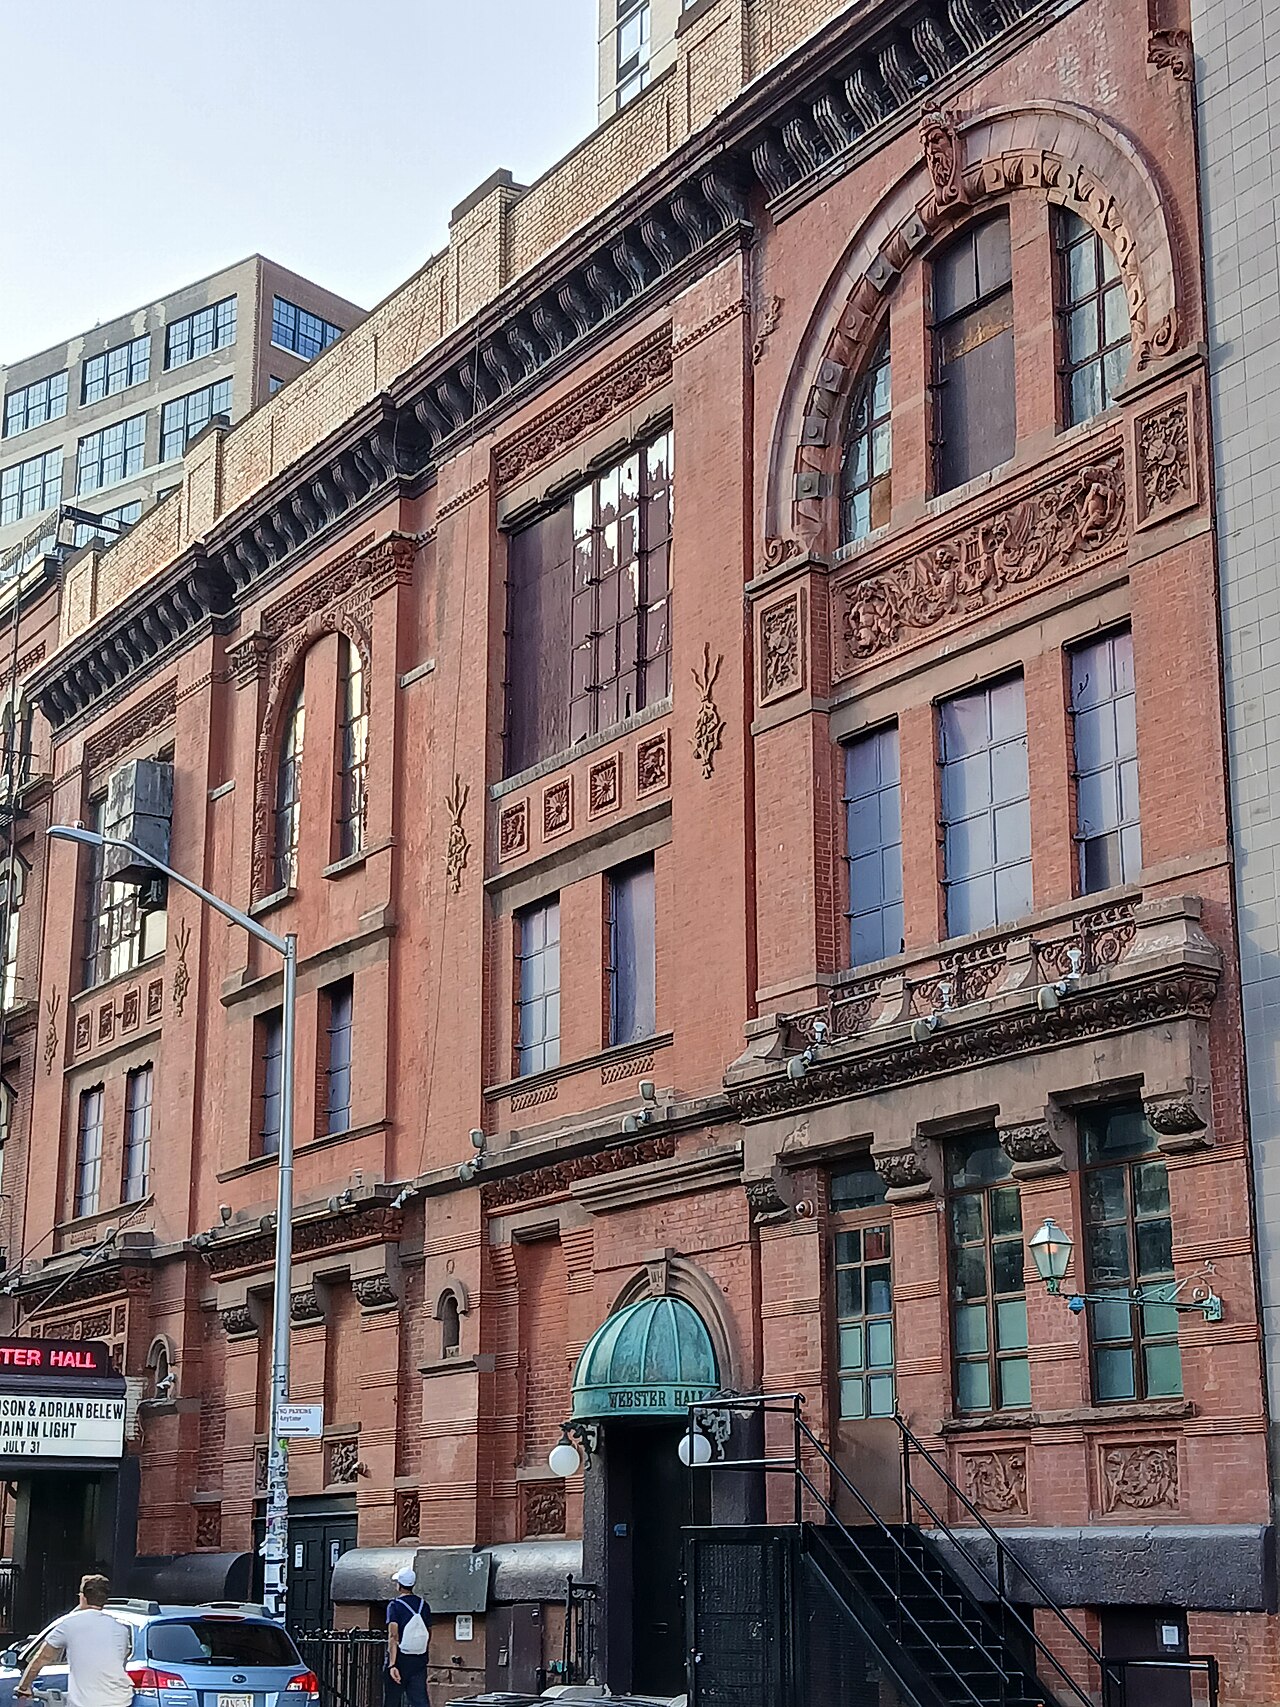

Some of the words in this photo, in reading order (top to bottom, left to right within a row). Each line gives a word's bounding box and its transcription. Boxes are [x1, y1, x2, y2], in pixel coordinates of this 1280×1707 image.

[0, 1348, 41, 1366] TER
[50, 1350, 96, 1368] HALL
[608, 1390, 667, 1408] WEBSTER
[0, 1400, 26, 1416] SON
[28, 1400, 36, 1416] &
[39, 1402, 84, 1418] ADRIAN
[86, 1403, 123, 1419] BELEW
[0, 1421, 23, 1437] AIN
[27, 1421, 39, 1437] IN
[42, 1421, 77, 1438] LIGHT
[3, 1440, 26, 1453] JULY
[30, 1441, 40, 1453] 31
